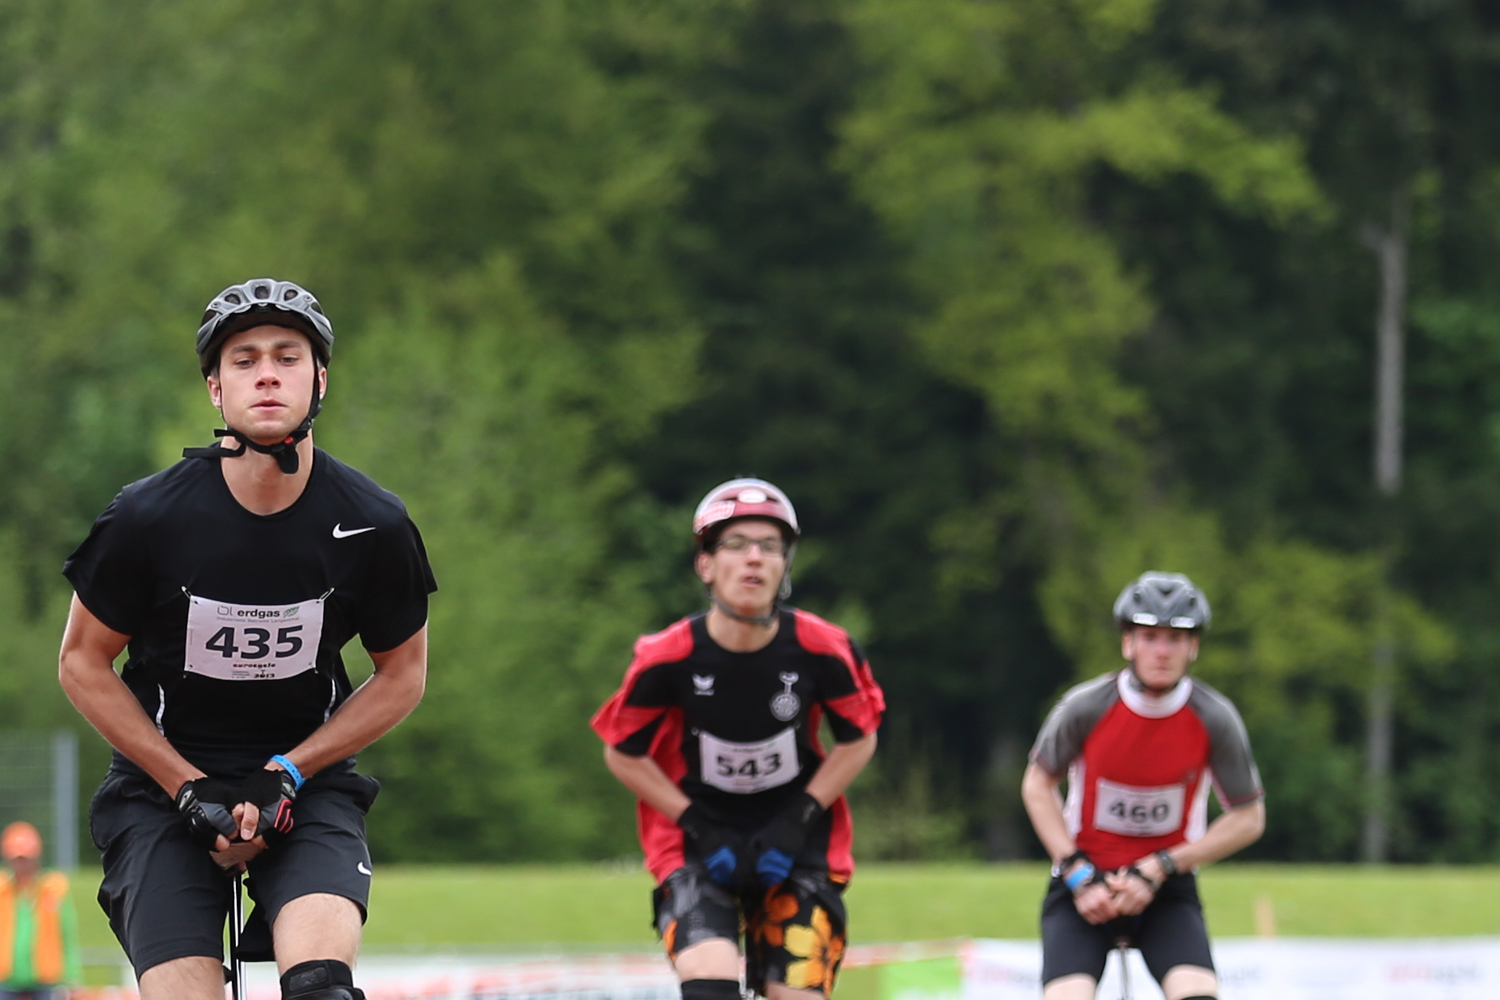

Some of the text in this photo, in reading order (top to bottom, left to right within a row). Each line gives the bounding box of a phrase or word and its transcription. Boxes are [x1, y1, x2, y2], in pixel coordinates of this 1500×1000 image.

[236, 608, 281, 620] erdgas
[204, 624, 304, 660] 435
[716, 752, 783, 778] 543
[1107, 800, 1171, 824] 460
